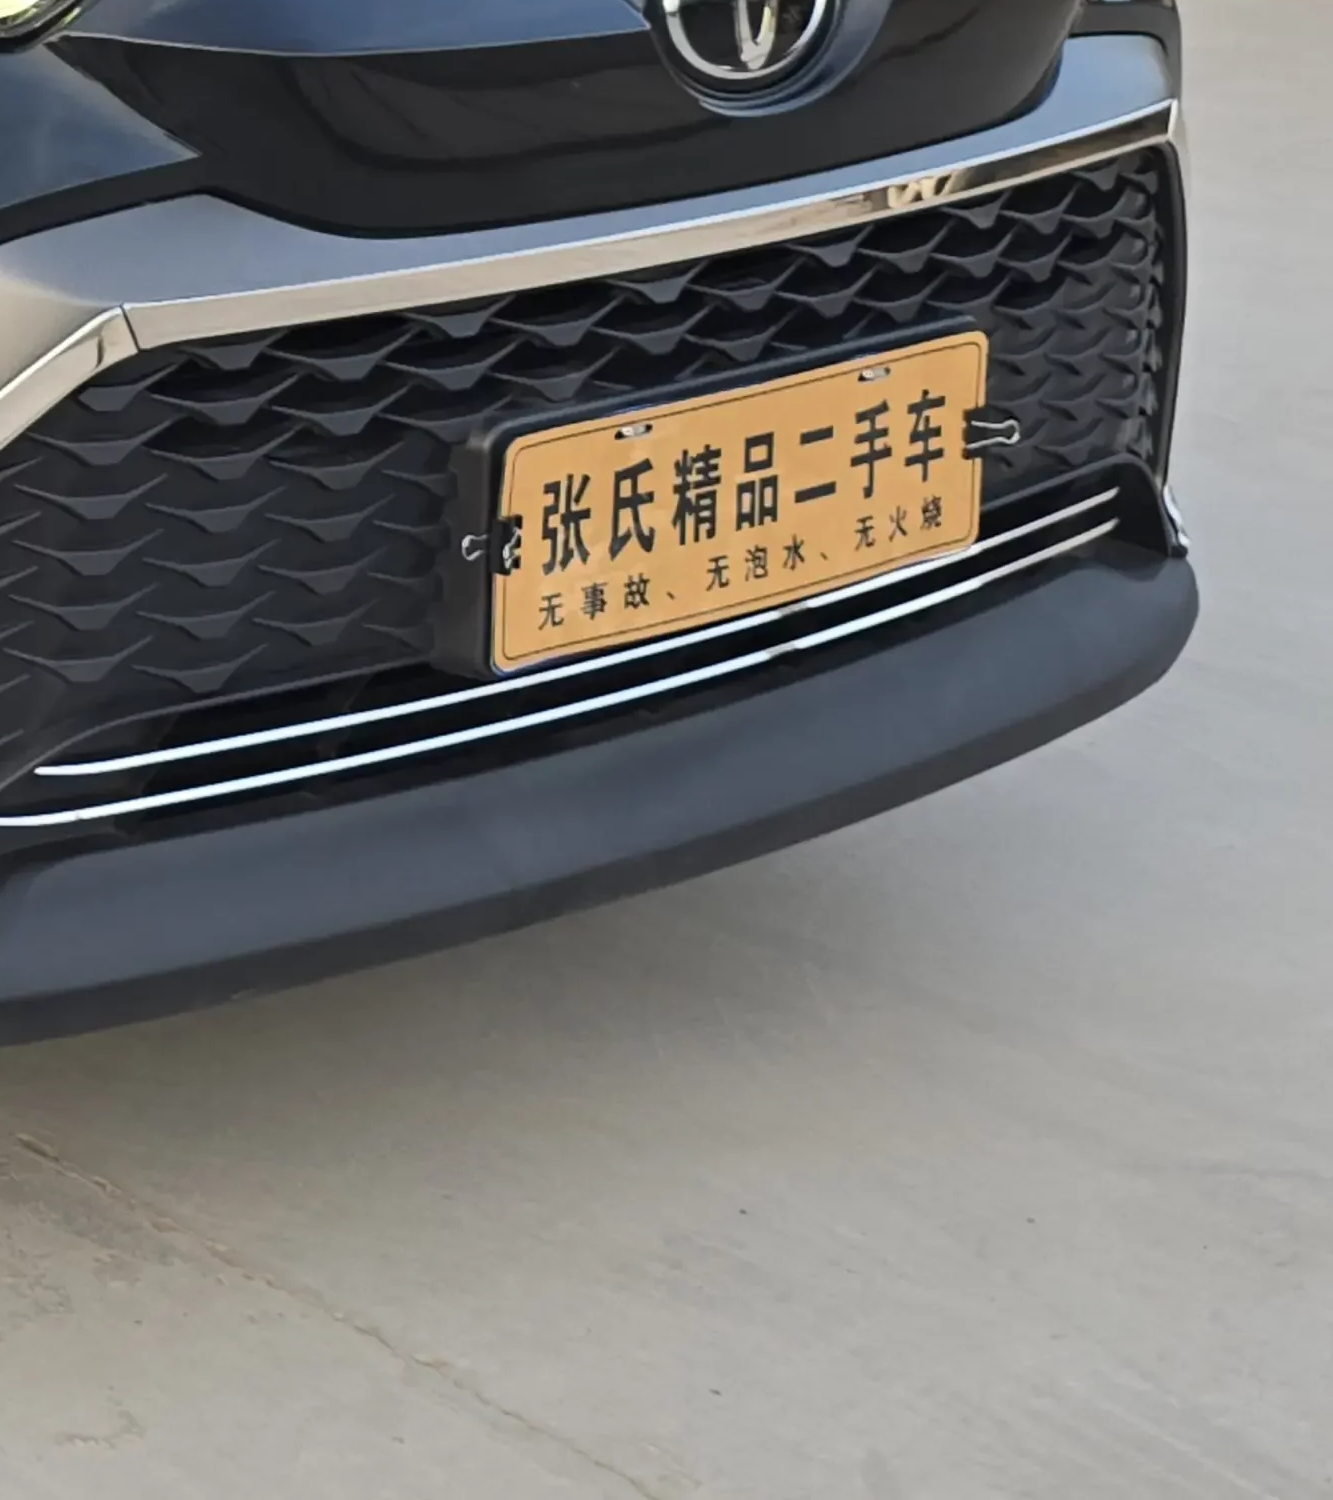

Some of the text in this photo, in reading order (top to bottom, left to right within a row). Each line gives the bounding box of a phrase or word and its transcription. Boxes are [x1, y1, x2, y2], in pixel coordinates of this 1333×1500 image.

[541, 389, 946, 576] 张氏精品二手车
